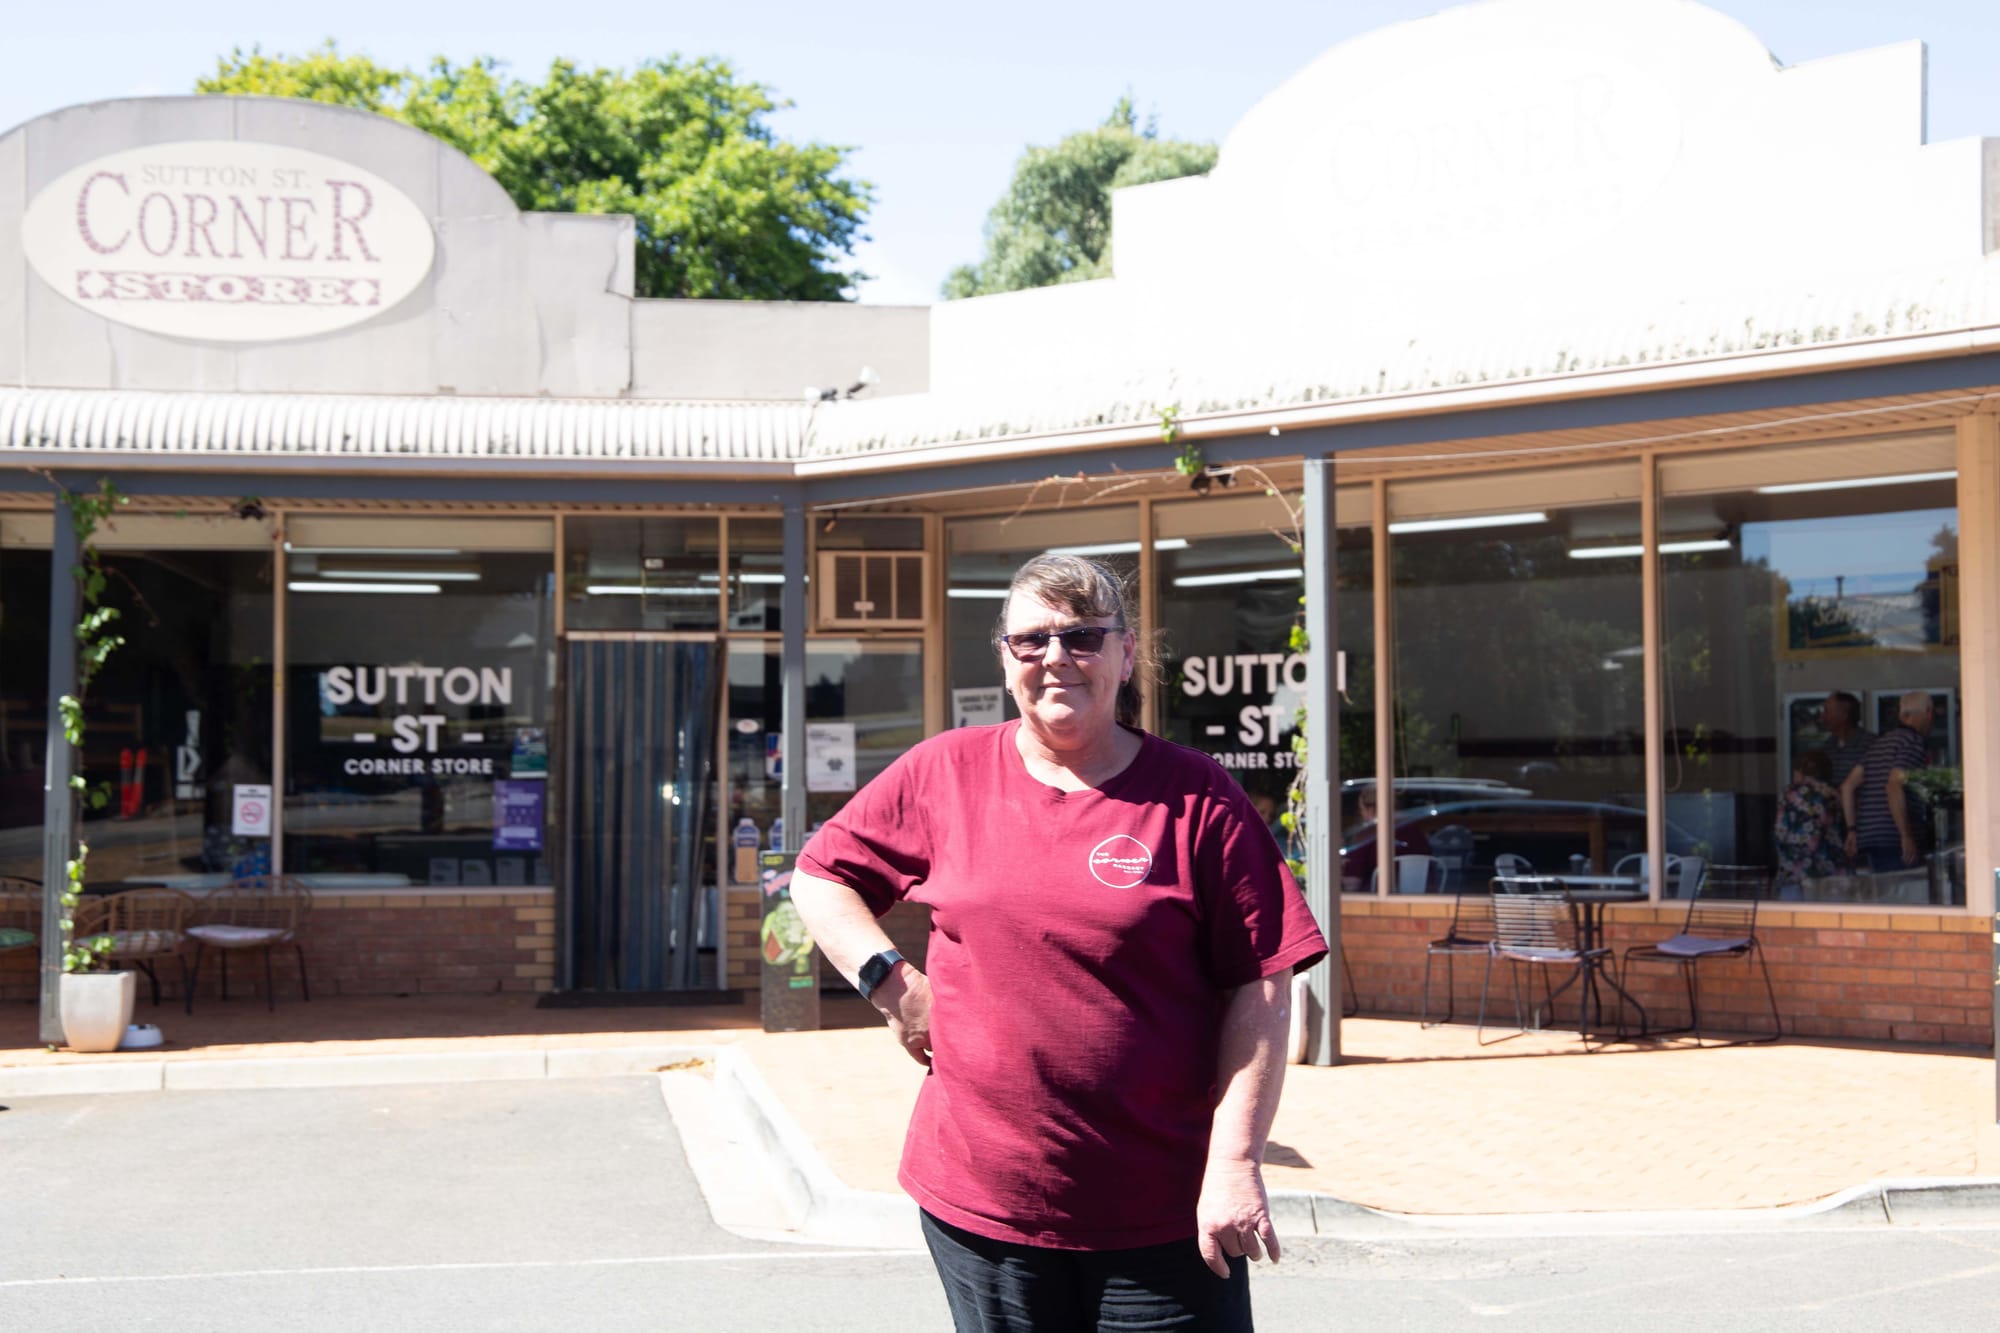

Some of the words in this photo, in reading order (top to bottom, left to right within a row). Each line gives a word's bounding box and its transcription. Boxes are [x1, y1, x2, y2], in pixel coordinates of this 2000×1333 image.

[1329, 72, 1621, 208] CORNER
[142, 164, 257, 187] SUTTON
[272, 168, 312, 189] ST.
[77, 171, 381, 262] CORNER
[107, 271, 346, 305] STORE
[326, 666, 512, 705] SUTTON
[391, 714, 446, 753] ST
[1238, 705, 1285, 746] ST
[344, 758, 424, 775] CORNER
[431, 758, 493, 774] STORE
[1212, 752, 1268, 769] ORNER
